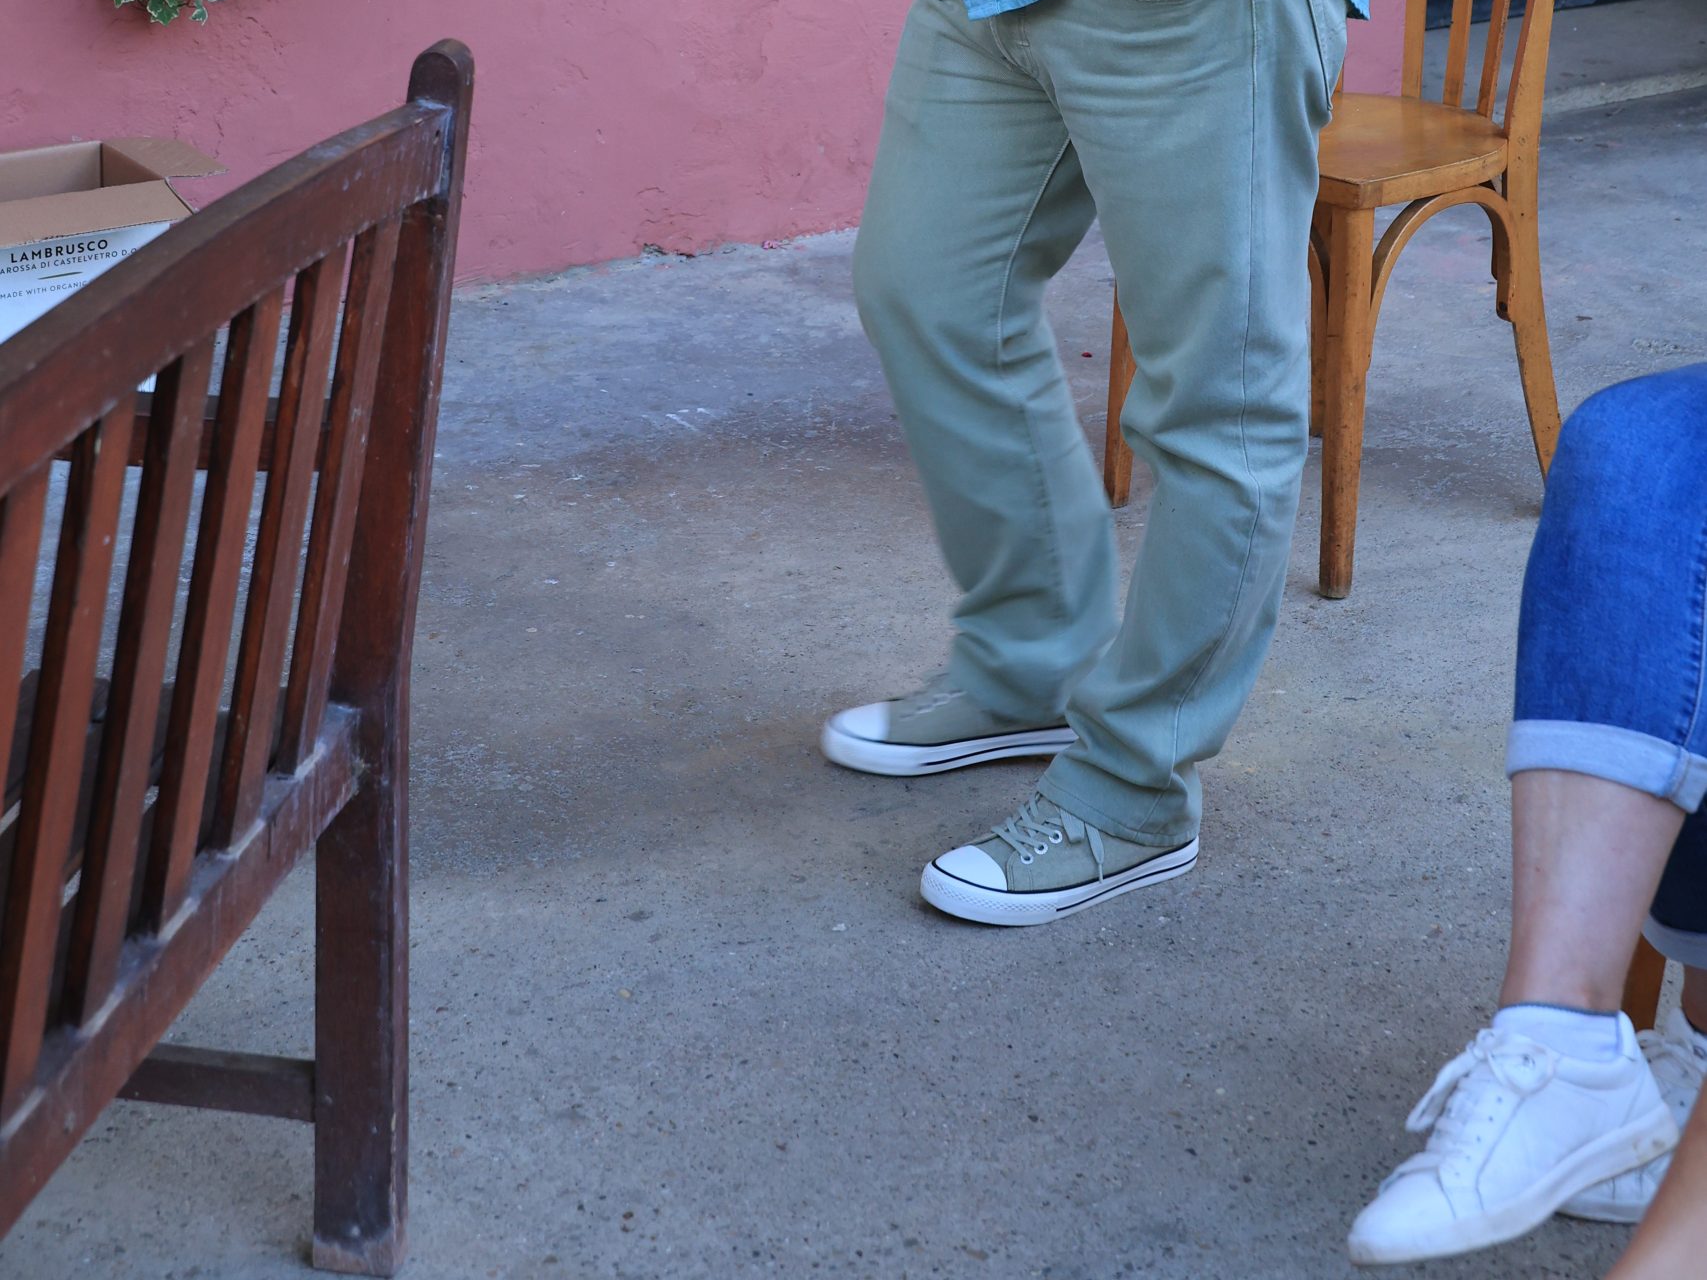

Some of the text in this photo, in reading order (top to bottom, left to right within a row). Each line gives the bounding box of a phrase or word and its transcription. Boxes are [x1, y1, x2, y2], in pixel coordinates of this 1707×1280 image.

[11, 239, 108, 263] LAMBRUSCO
[40, 261, 50, 269] DI
[53, 250, 118, 267] CASTELVETRO
[0, 290, 23, 299] MADE
[26, 287, 47, 295] WITH
